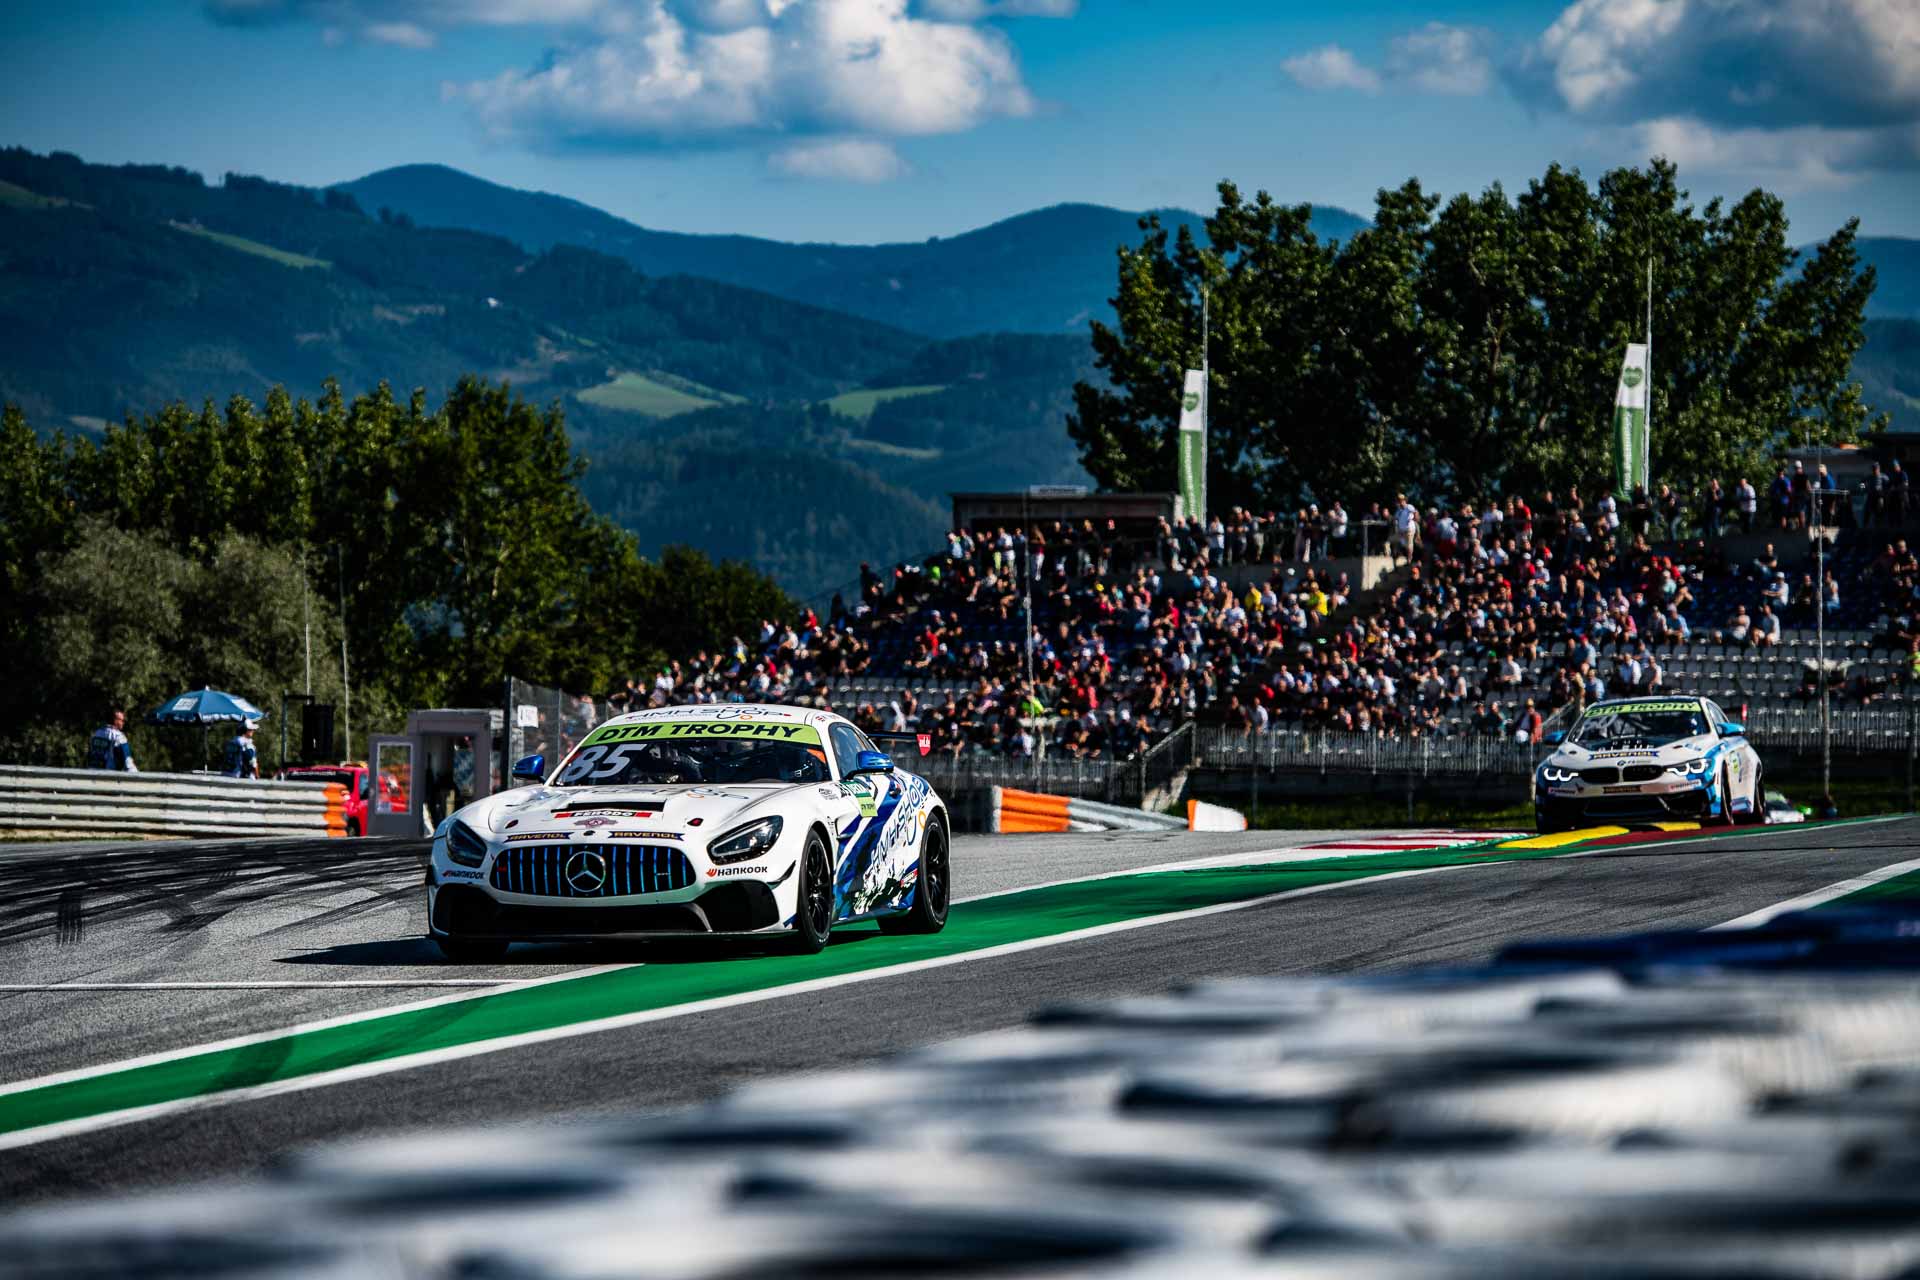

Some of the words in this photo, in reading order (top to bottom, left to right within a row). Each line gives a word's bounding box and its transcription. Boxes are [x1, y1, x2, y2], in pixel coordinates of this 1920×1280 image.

[597, 725, 664, 742] DTM
[671, 723, 802, 738] TROPHY
[562, 743, 648, 782] 85
[614, 831, 680, 840] RAVENOL
